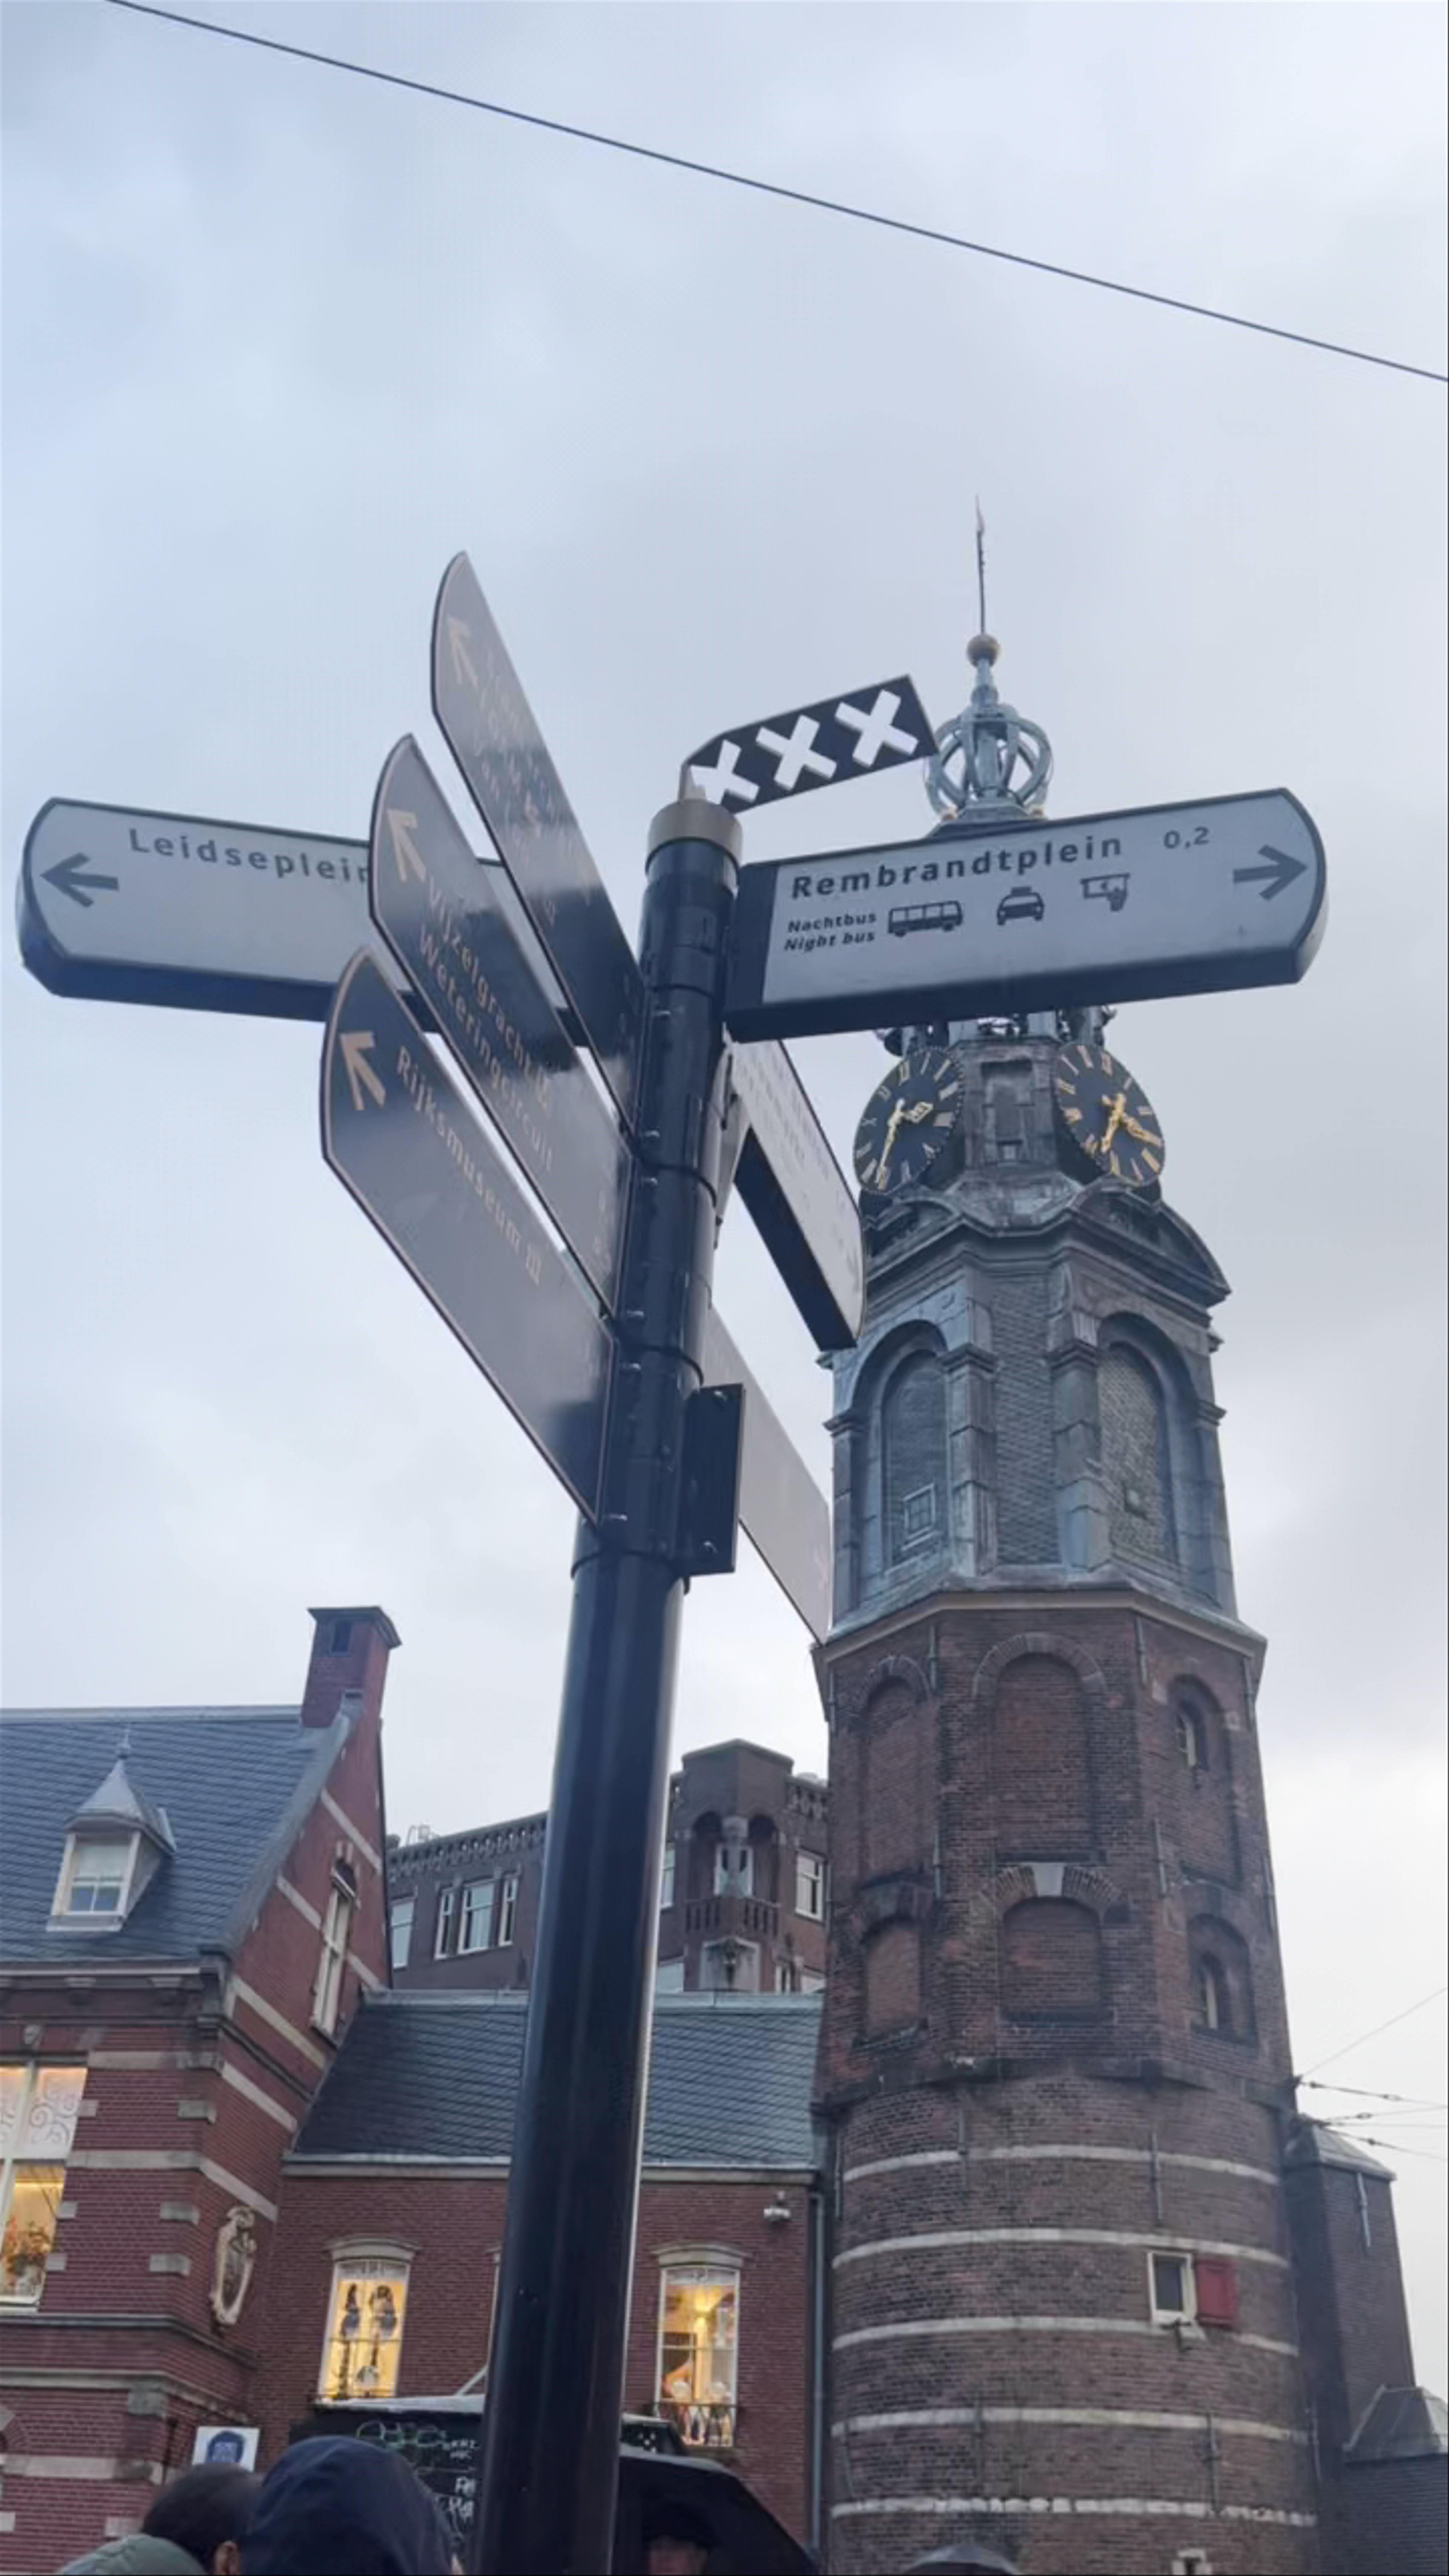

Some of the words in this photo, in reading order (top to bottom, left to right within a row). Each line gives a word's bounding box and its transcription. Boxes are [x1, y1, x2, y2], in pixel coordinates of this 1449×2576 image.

[791, 834, 1123, 900] Rembrandtplein
[1163, 826, 1211, 850] 0,2
[784, 934, 837, 953] Night
[842, 931, 875, 944] bus
[788, 912, 876, 933] Nachtbus
[429, 874, 531, 1079] Vijzelgracht
[397, 1045, 521, 1256] Rijksmuseum
